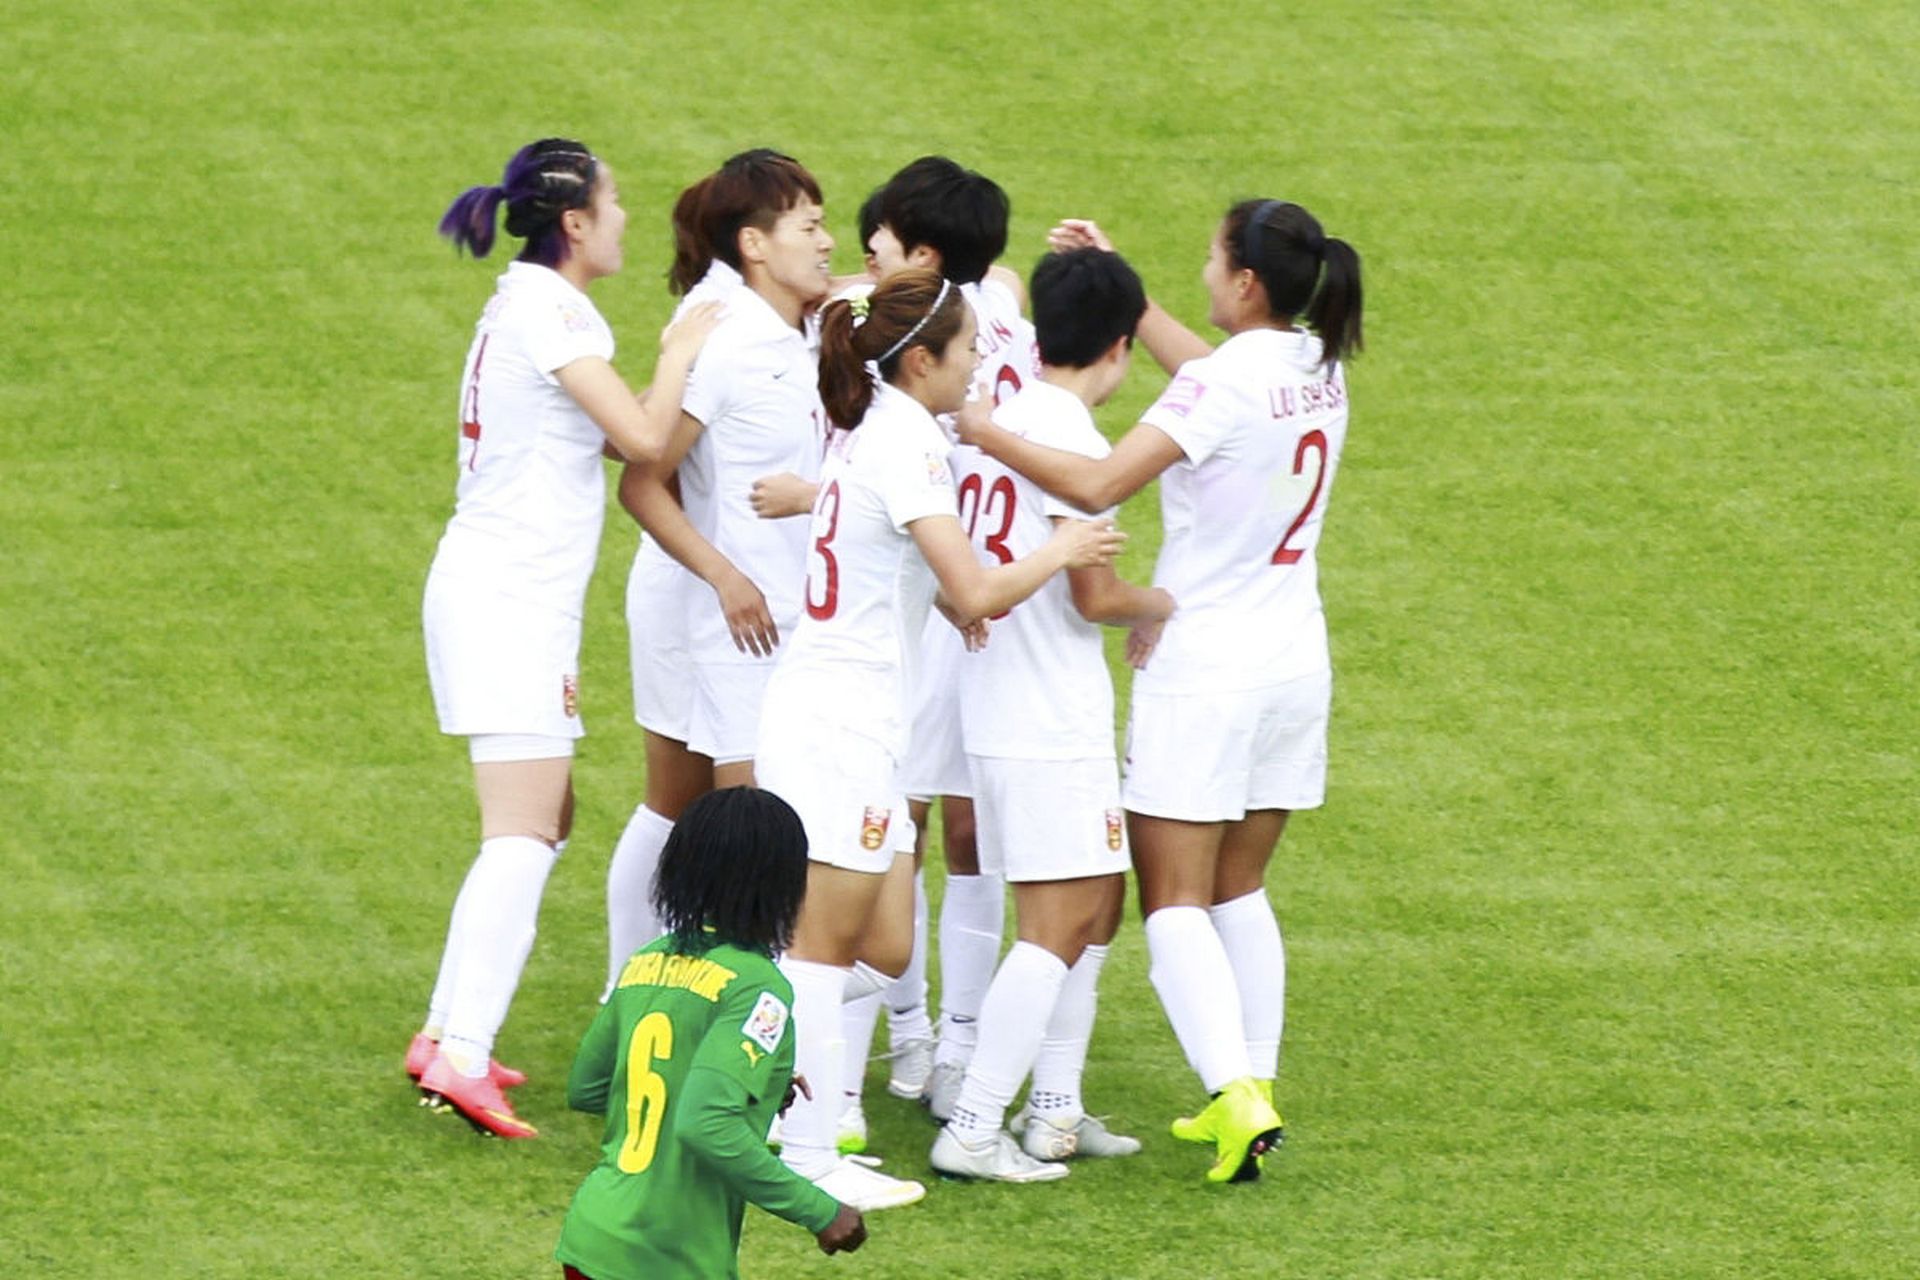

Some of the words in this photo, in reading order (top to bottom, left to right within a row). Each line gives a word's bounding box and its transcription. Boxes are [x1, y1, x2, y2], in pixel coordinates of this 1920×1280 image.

[806, 479, 840, 621] 3
[1269, 428, 1327, 565] 2
[617, 1011, 673, 1174] 6
